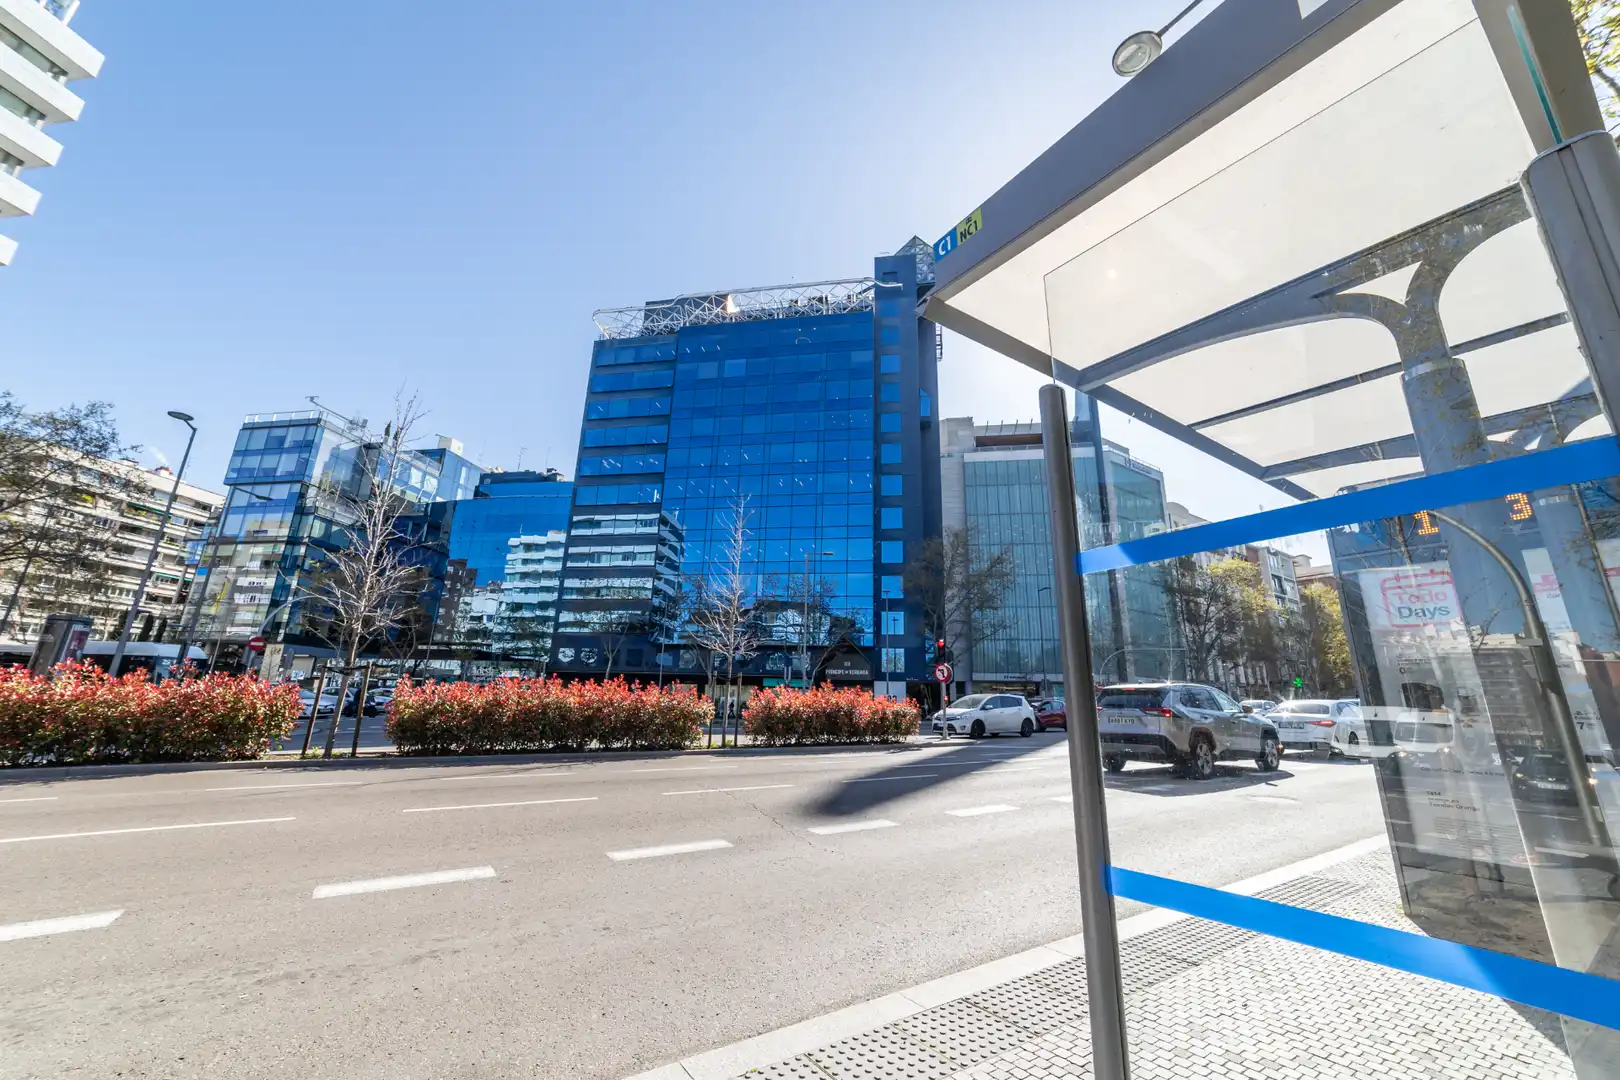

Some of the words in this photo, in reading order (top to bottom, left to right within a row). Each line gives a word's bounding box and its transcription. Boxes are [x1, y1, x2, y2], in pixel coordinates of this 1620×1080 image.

[960, 219, 979, 243] NC1
[938, 235, 952, 256] C1
[1392, 588, 1448, 605] Todo
[1397, 605, 1451, 620] Days
